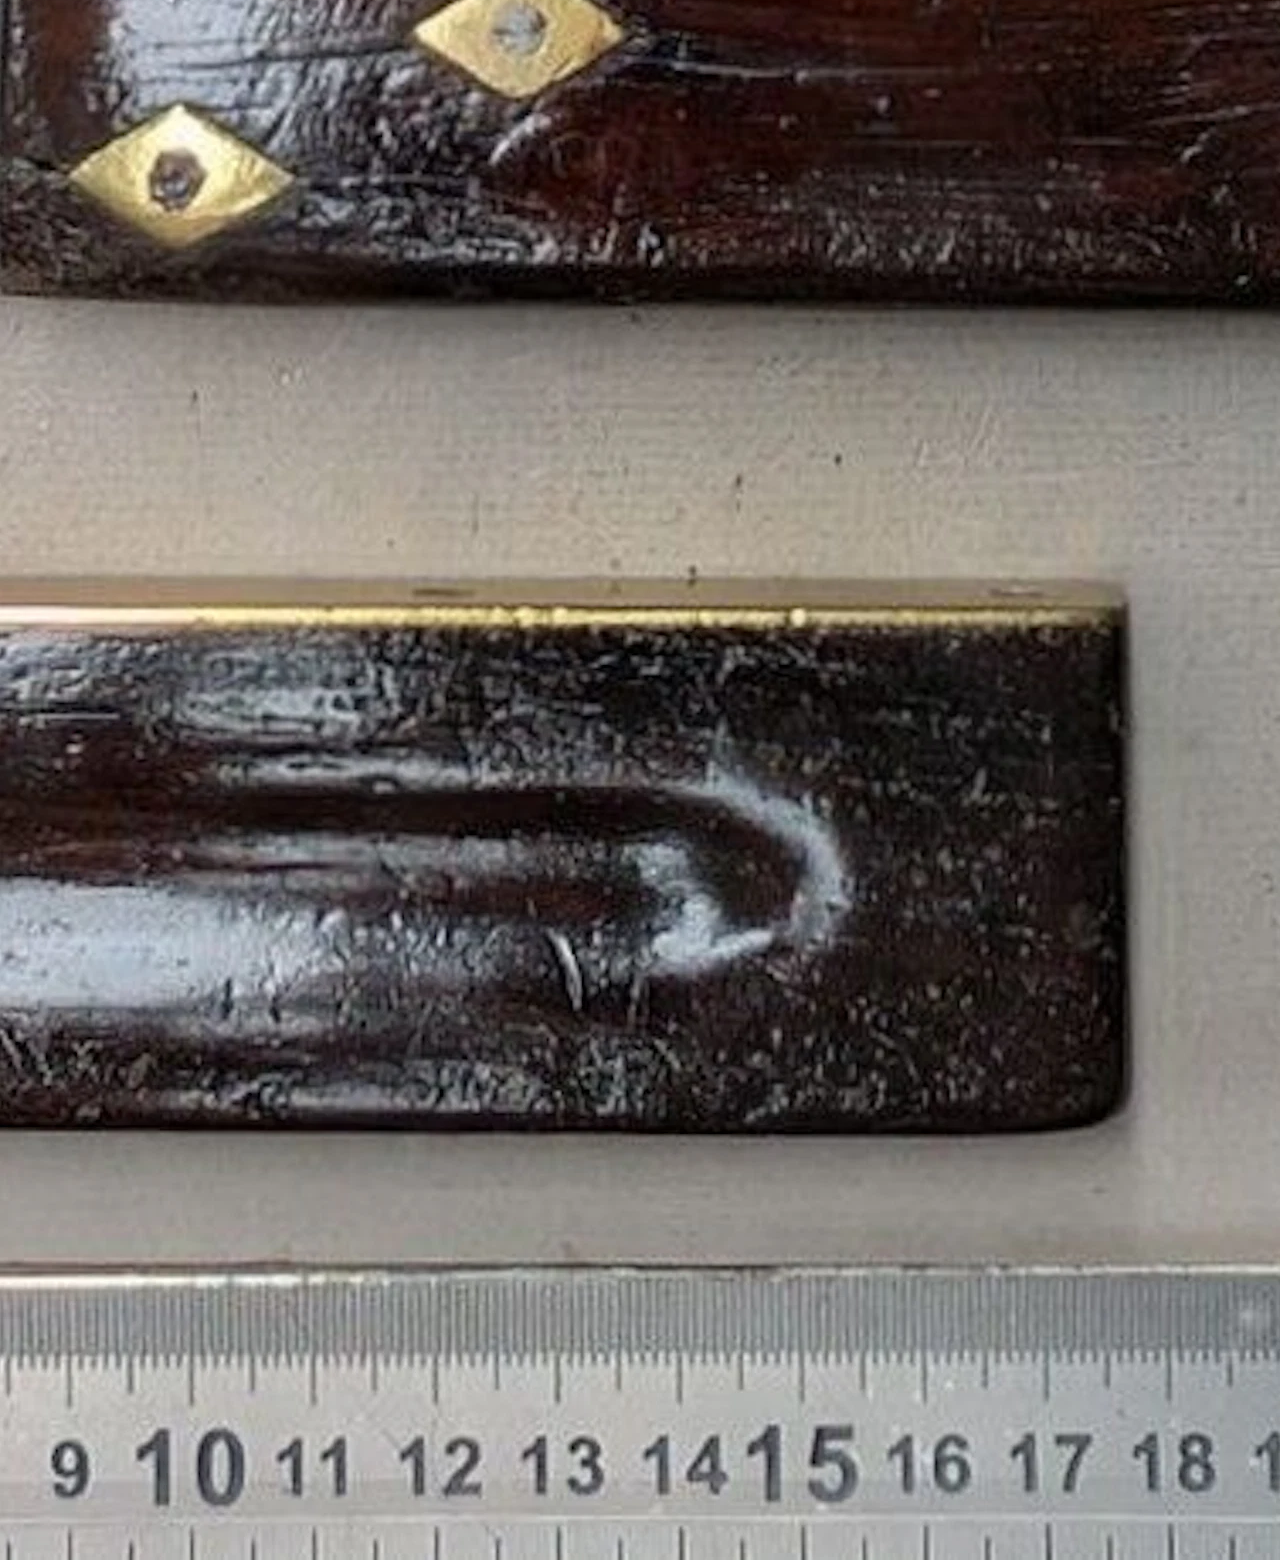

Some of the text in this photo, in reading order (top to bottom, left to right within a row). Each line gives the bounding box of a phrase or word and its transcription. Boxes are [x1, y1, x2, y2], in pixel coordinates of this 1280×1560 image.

[50, 1440, 91, 1498] 9
[136, 1428, 246, 1506] 10
[276, 1437, 349, 1496] 11
[399, 1437, 482, 1496] 12
[521, 1437, 605, 1495] 13
[643, 1436, 728, 1494] 14
[746, 1425, 859, 1503] 15
[887, 1434, 972, 1494] 16
[1010, 1434, 1092, 1492] 17
[1133, 1432, 1216, 1492] 18
